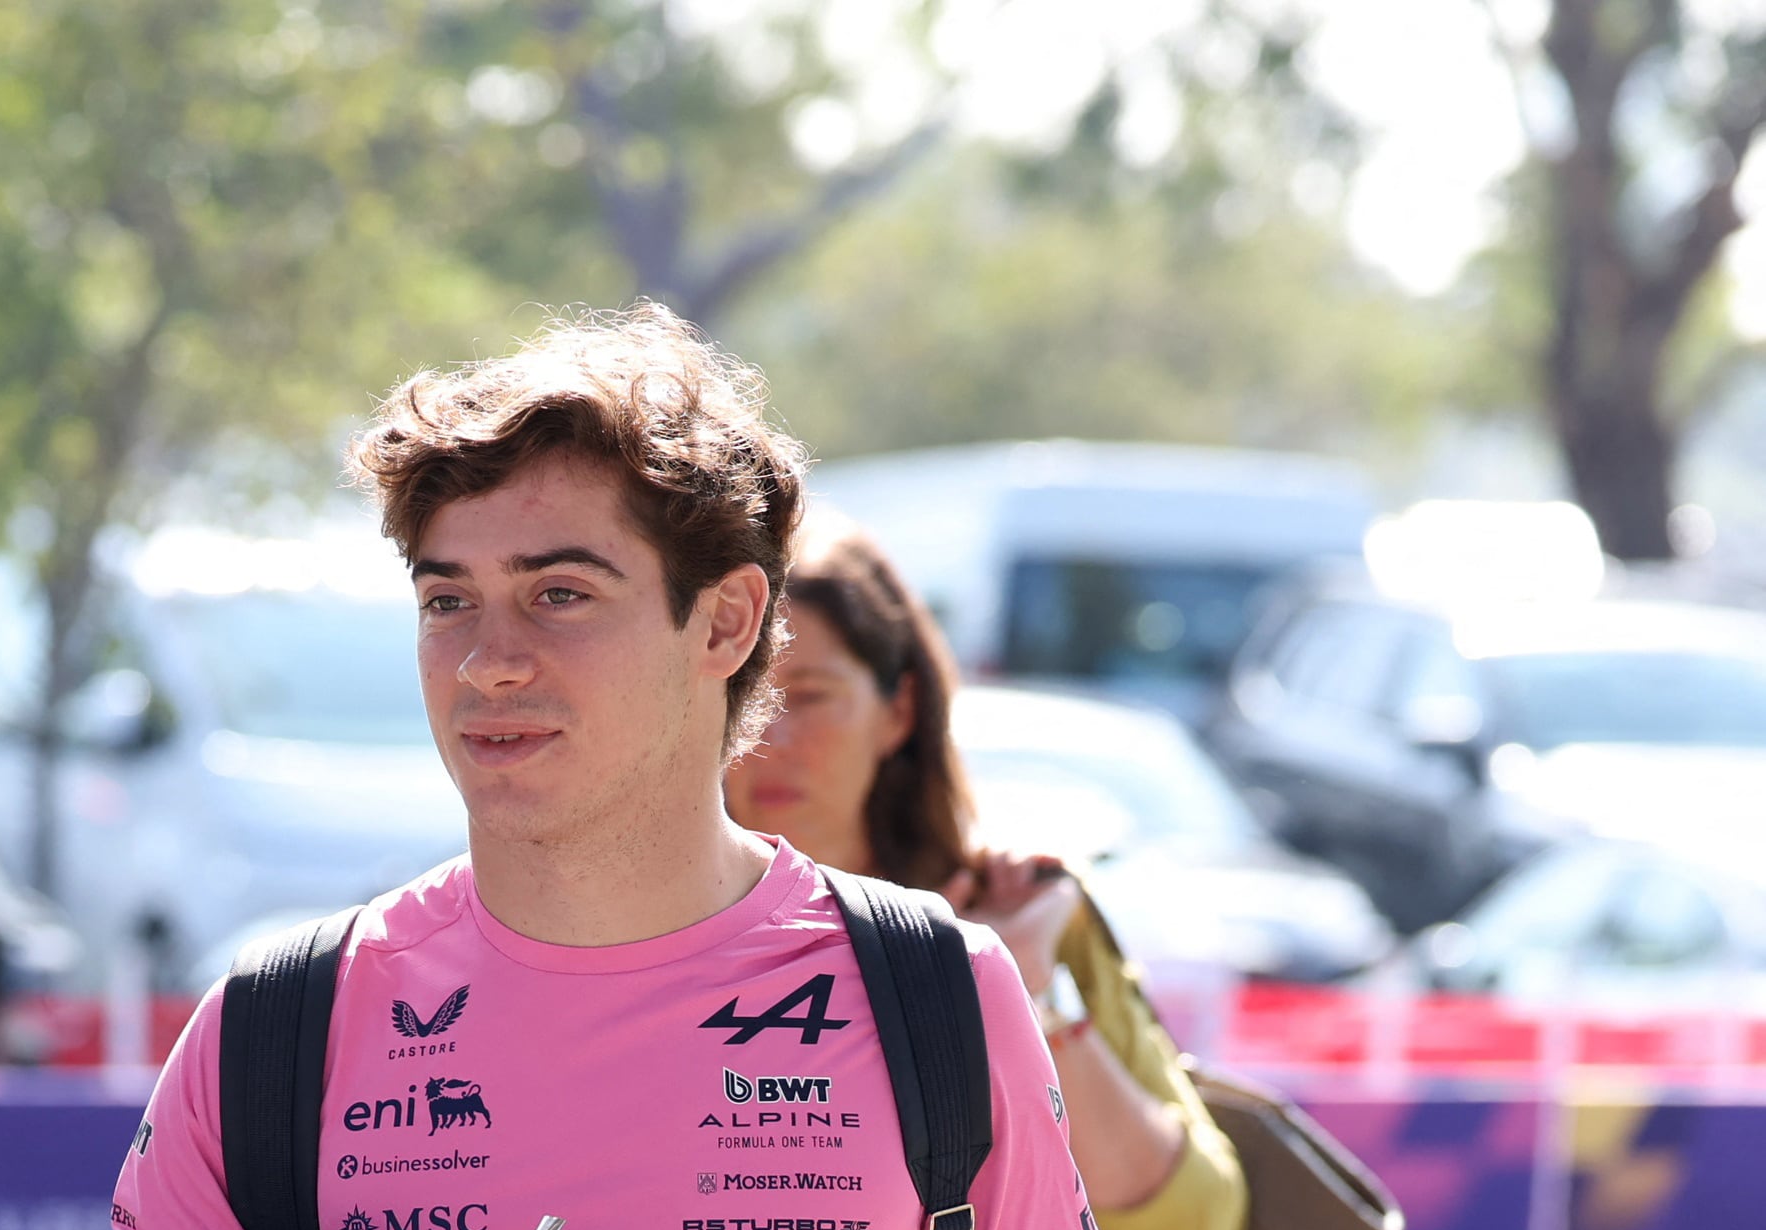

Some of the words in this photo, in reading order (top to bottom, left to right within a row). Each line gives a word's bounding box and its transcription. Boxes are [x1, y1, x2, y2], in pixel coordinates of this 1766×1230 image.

[388, 1040, 457, 1060] CASTORE
[756, 1076, 831, 1104] BWT
[343, 1084, 417, 1133] eni
[698, 1112, 861, 1129] ALPINE
[718, 1136, 775, 1149] FORMULA
[781, 1136, 805, 1148] ONE
[812, 1136, 843, 1149] TEAM
[361, 1150, 491, 1176] businessolver
